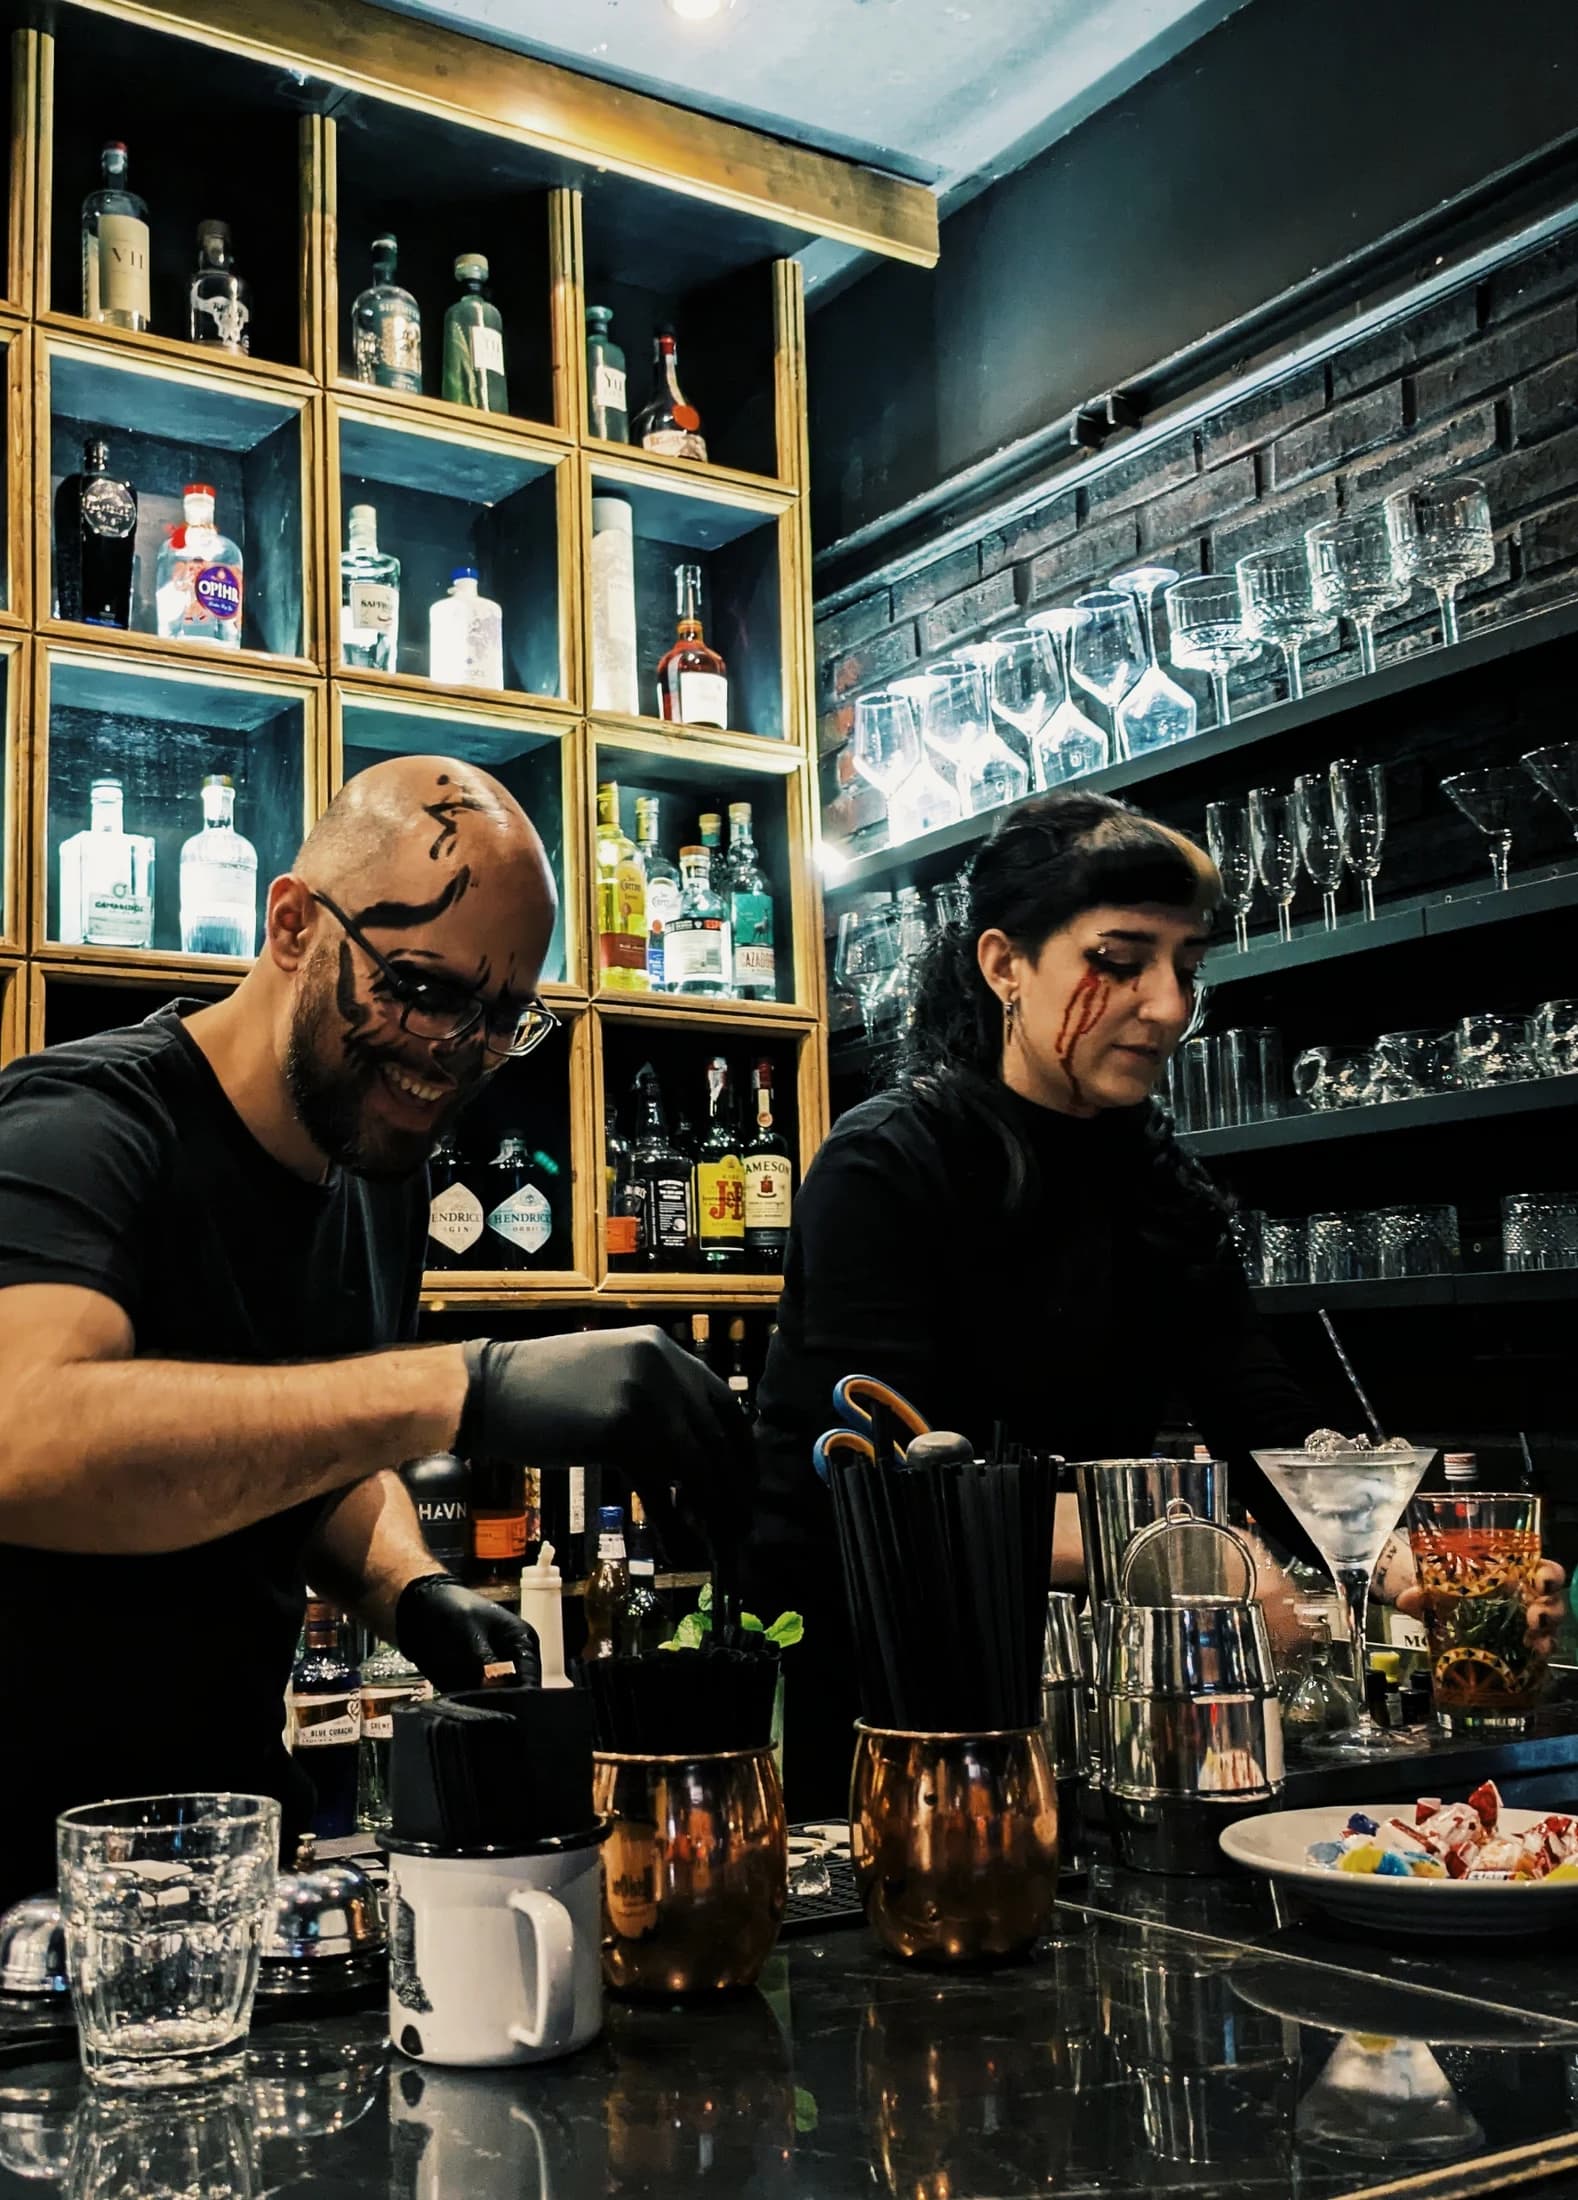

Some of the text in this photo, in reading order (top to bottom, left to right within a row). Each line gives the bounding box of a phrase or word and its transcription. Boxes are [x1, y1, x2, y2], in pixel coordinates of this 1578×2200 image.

[198, 579, 240, 604] OPIHR
[745, 1161, 789, 1175] AMESON
[418, 1502, 467, 1521] HAVN
